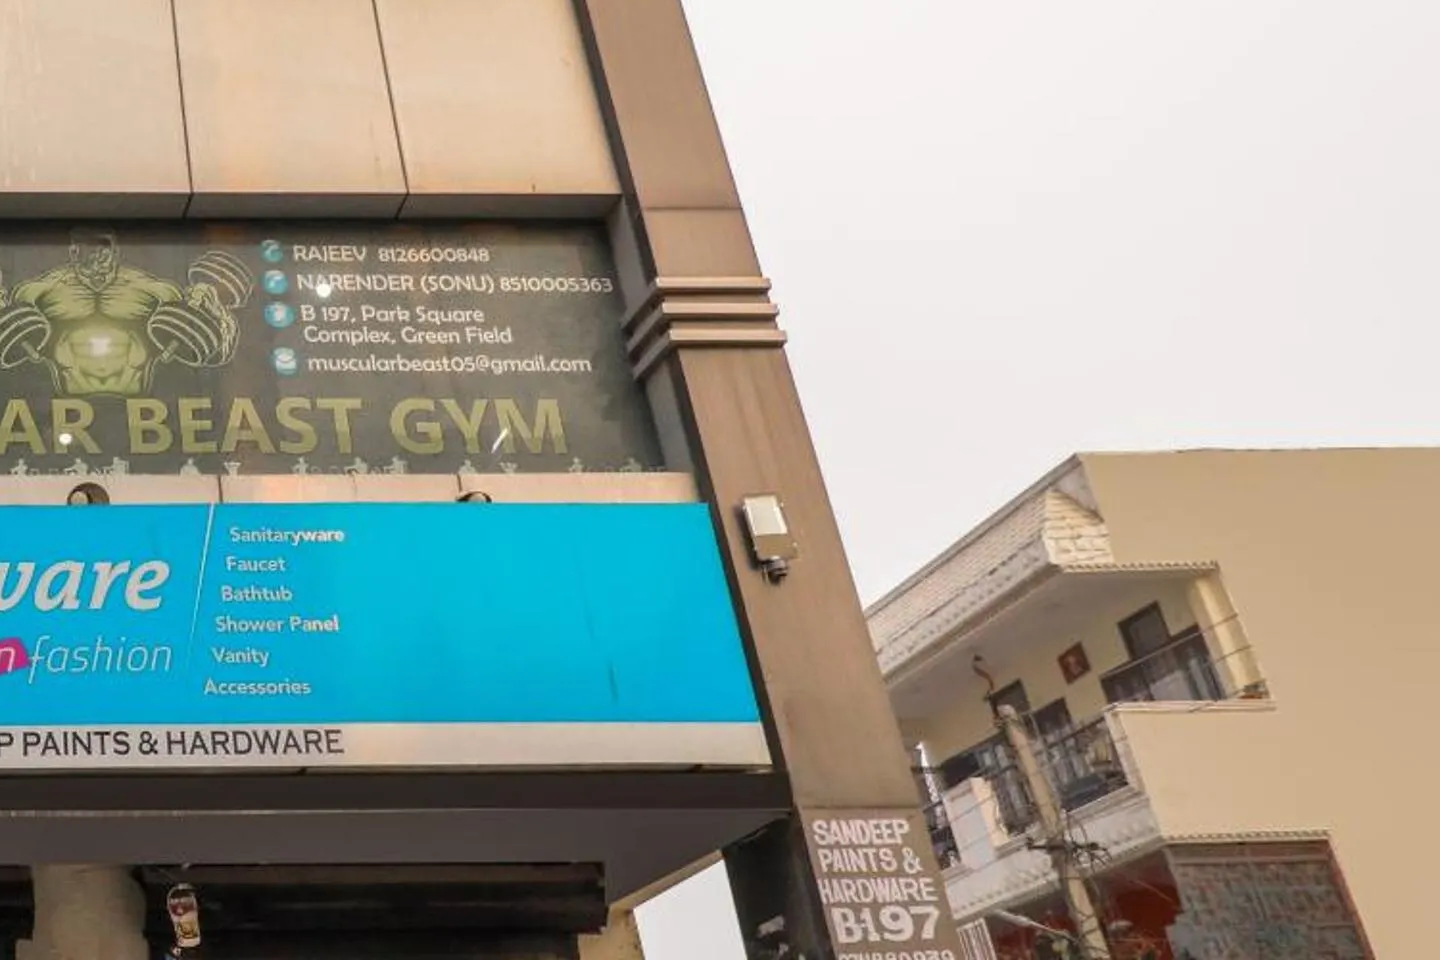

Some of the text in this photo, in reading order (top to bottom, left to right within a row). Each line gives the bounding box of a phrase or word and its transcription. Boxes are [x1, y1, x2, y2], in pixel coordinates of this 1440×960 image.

[293, 245, 490, 263] RAJEEV 8126600848
[296, 274, 614, 294] NARENDER (SONU) 8510005363
[300, 305, 485, 326] B 197, Park Square
[303, 326, 513, 346] Complex, Green Field
[307, 354, 593, 375] muscularbeast05@gmail.com
[125, 395, 362, 455] BEAST
[389, 396, 569, 456] GYM
[229, 526, 345, 546] Sanitaryware
[225, 556, 286, 572] Faucet
[220, 585, 293, 602] Bathtub
[215, 614, 340, 632] Shower Panel
[27, 637, 172, 683] fashion
[211, 647, 270, 667] Vanity
[203, 678, 312, 695] Accessories
[22, 731, 134, 757] PAINTS
[137, 731, 160, 757] &
[165, 729, 346, 757] HARDWARE
[812, 818, 910, 846] SANDEEP
[817, 846, 924, 875] PAINTS &
[816, 876, 940, 905] HARDWARE
